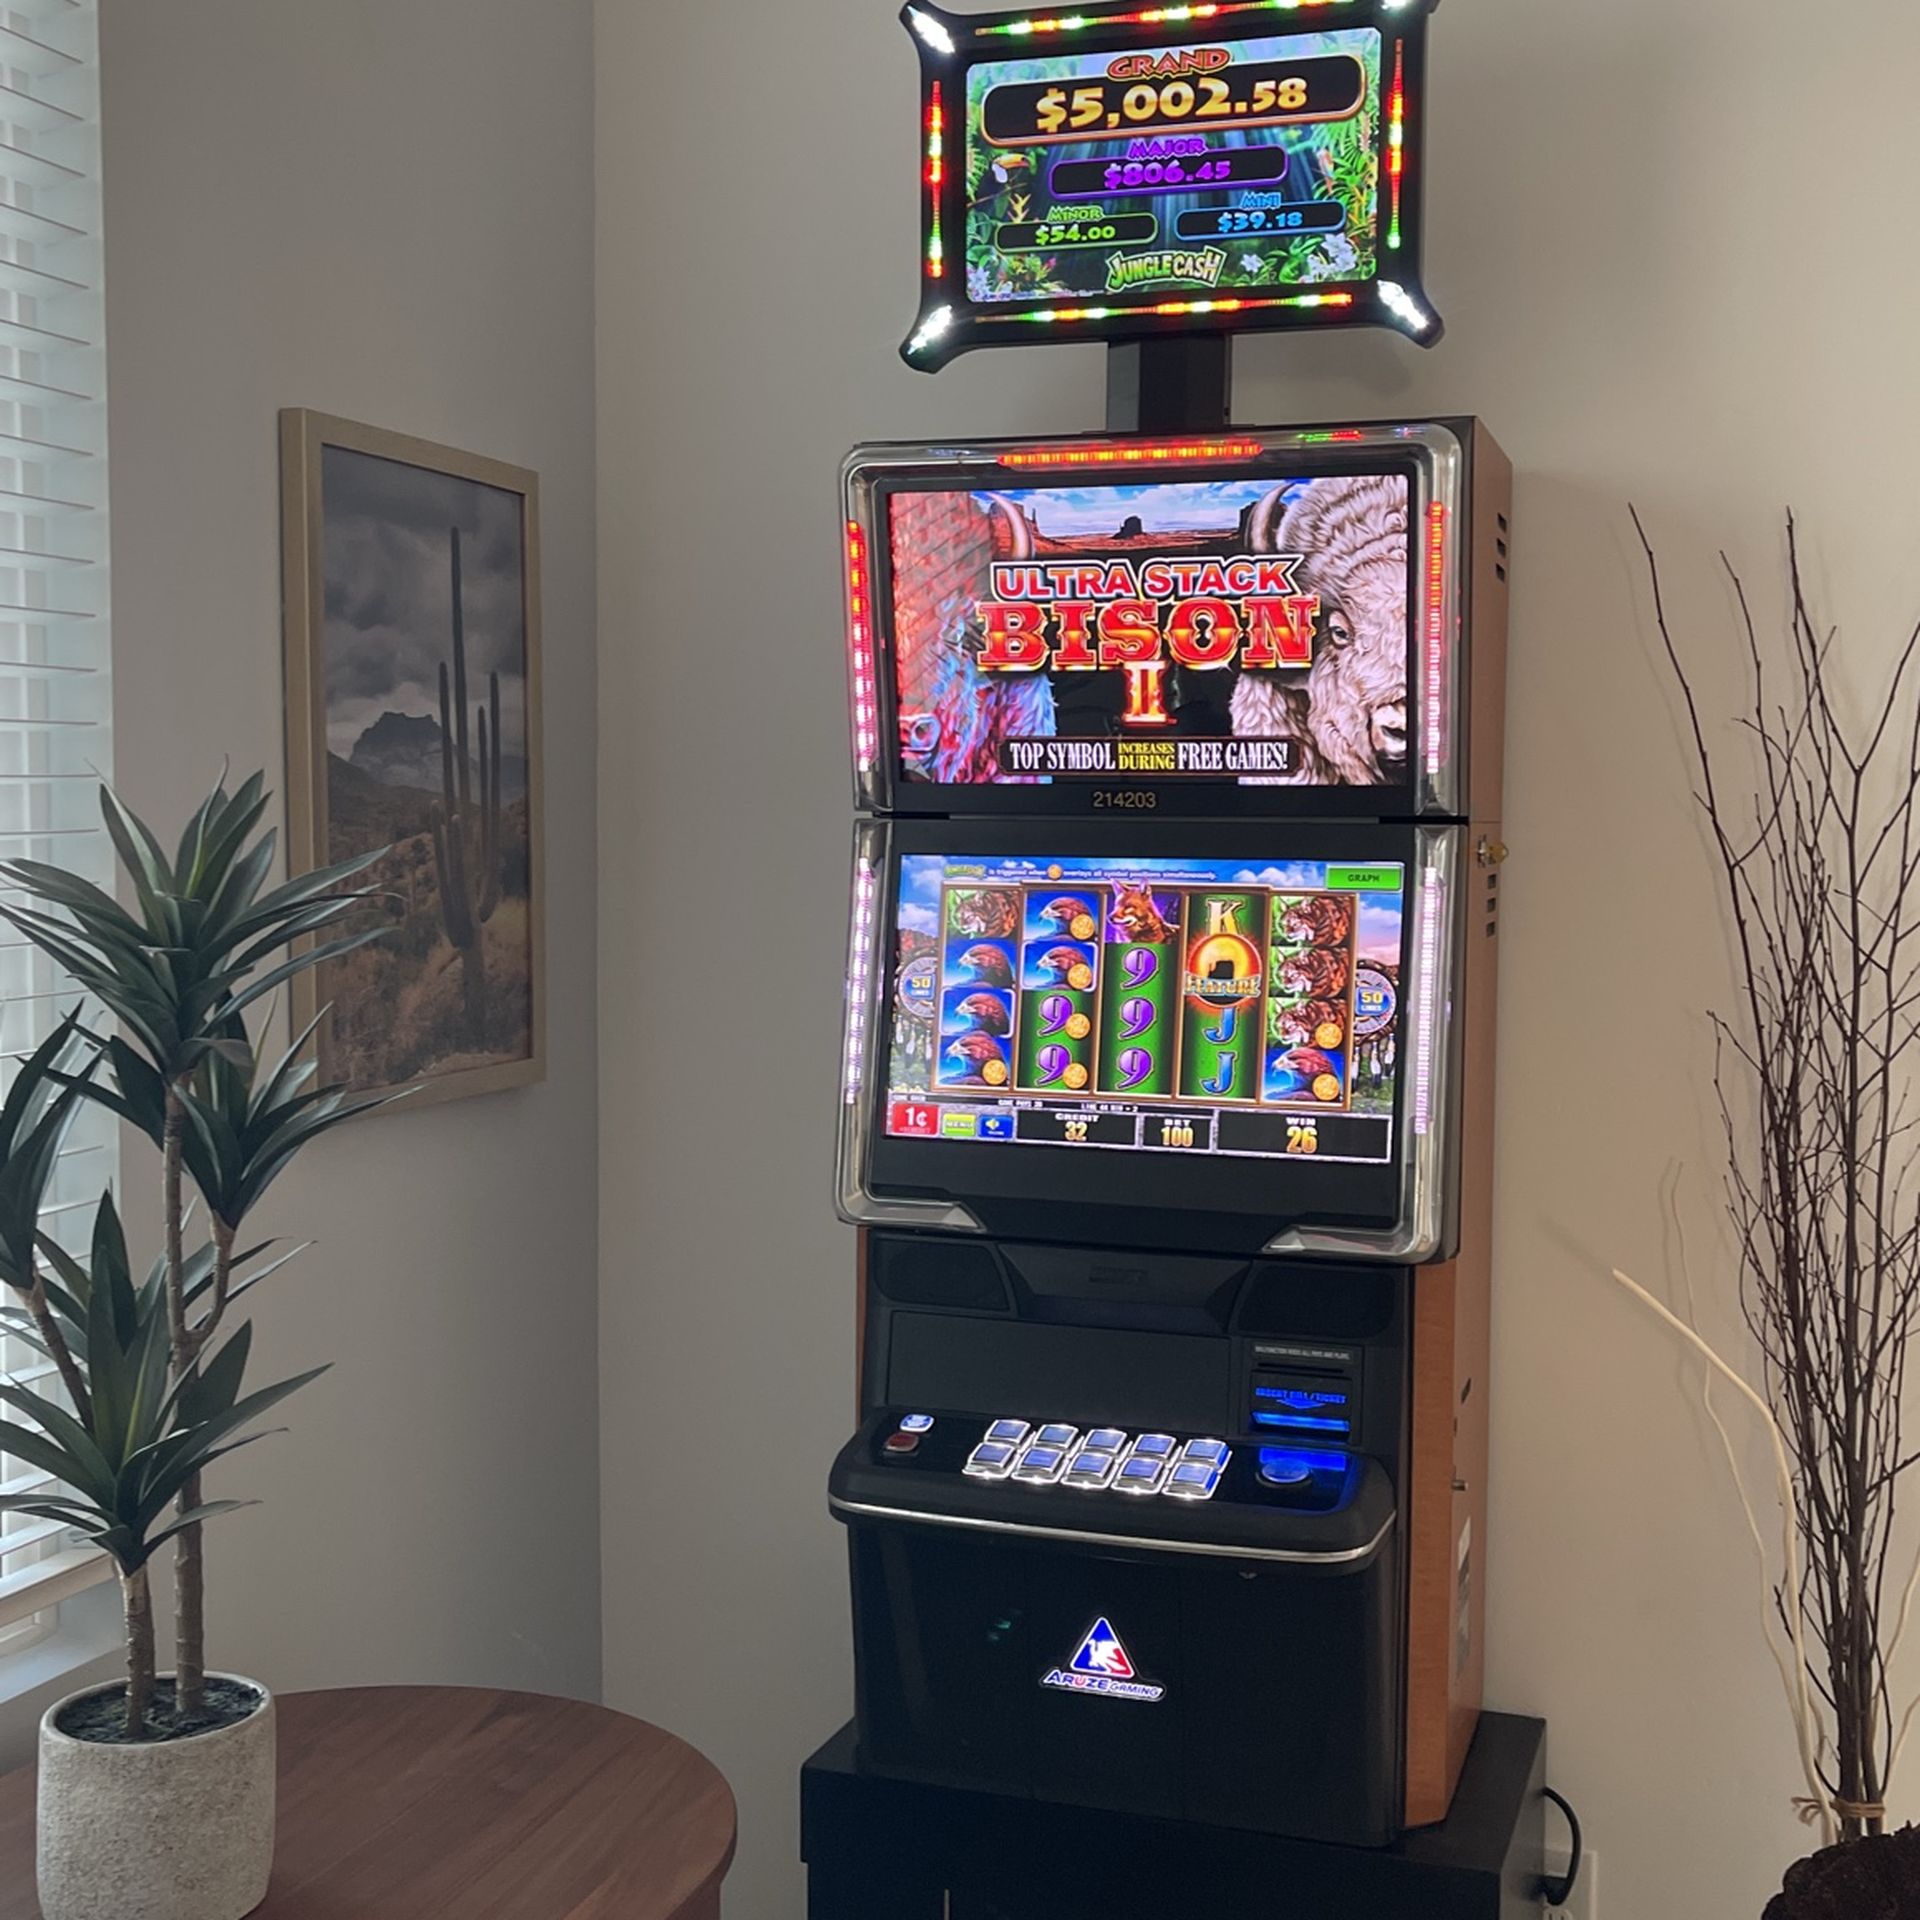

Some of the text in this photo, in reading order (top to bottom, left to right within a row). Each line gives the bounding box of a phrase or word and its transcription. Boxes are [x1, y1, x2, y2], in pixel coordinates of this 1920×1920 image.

[1108, 49, 1231, 80] GRAND
[1036, 77, 1308, 133] $5,002.58
[1127, 135, 1208, 160] MAJOR
[1104, 160, 1231, 189] $806.45
[1050, 206, 1105, 222] MINOR
[1240, 193, 1281, 210] MINI
[1035, 222, 1117, 246] $54.00
[1217, 211, 1303, 233] $39.18
[1108, 250, 1224, 290] JUNGLE CASH
[995, 561, 1293, 600] ULTRA STACK
[976, 595, 1321, 671] BISON
[1122, 660, 1170, 727] II
[1010, 743, 1116, 770] TOP SYMBOL
[1118, 743, 1175, 754] INCREASES
[1177, 743, 1289, 770] FREE GAMES!
[1118, 755, 1175, 770] DURING
[1092, 792, 1157, 808] 214203
[1347, 875, 1380, 883] GRAPH
[1206, 898, 1244, 935] K
[1120, 947, 1159, 990] 9
[911, 976, 931, 989] 50
[1360, 991, 1384, 1004] 50
[1038, 994, 1074, 1037] 9
[1118, 997, 1156, 1040] 9
[1202, 1007, 1239, 1045] J
[1035, 1043, 1071, 1086] 9
[1115, 1047, 1154, 1090] 9
[1200, 1051, 1237, 1095] J
[905, 1106, 927, 1128] 1¢
[1055, 1113, 1099, 1122] CREDIT
[1286, 1117, 1316, 1126] WIN
[1064, 1121, 1087, 1141] 32
[1160, 1126, 1194, 1147] 100
[1286, 1126, 1318, 1154] 26
[1043, 1669, 1162, 1698] ARUZE GAMING
